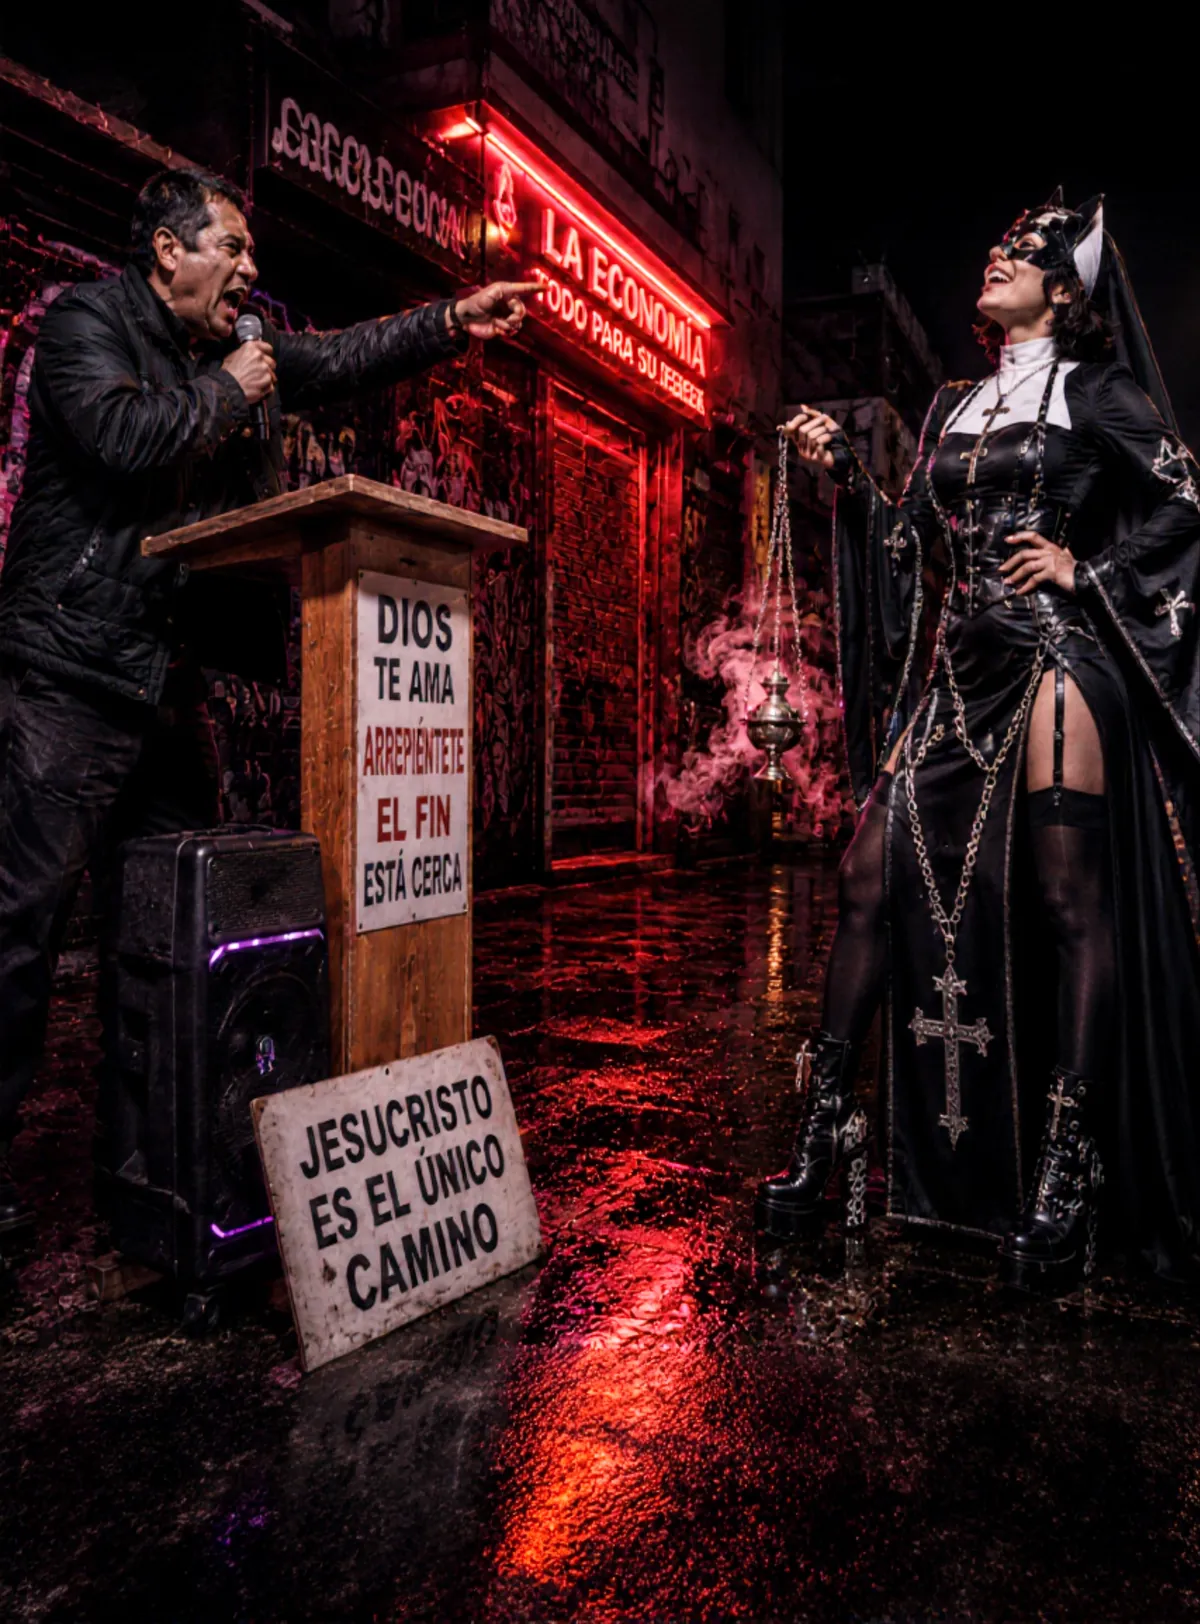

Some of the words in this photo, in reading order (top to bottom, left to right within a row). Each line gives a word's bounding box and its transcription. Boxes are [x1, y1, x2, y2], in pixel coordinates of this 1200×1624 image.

[542, 208, 583, 281] LA
[588, 246, 706, 377] ECONOMÍA
[592, 311, 633, 364] PARA
[637, 345, 657, 379] SU
[377, 594, 453, 652] DIOS
[374, 656, 401, 701] TE
[409, 660, 454, 705] AMA
[363, 717, 465, 777] ARREPIÉNTETE
[377, 798, 407, 843] EL
[415, 794, 451, 840] FIN
[363, 849, 407, 907] ESTÁ
[411, 852, 462, 899] CERCA
[300, 1075, 492, 1179] JESUCRISTO
[309, 1186, 358, 1250] ES
[366, 1170, 411, 1227] EL
[415, 1134, 505, 1206] ÚNICO
[345, 1203, 499, 1311] CAMINO
